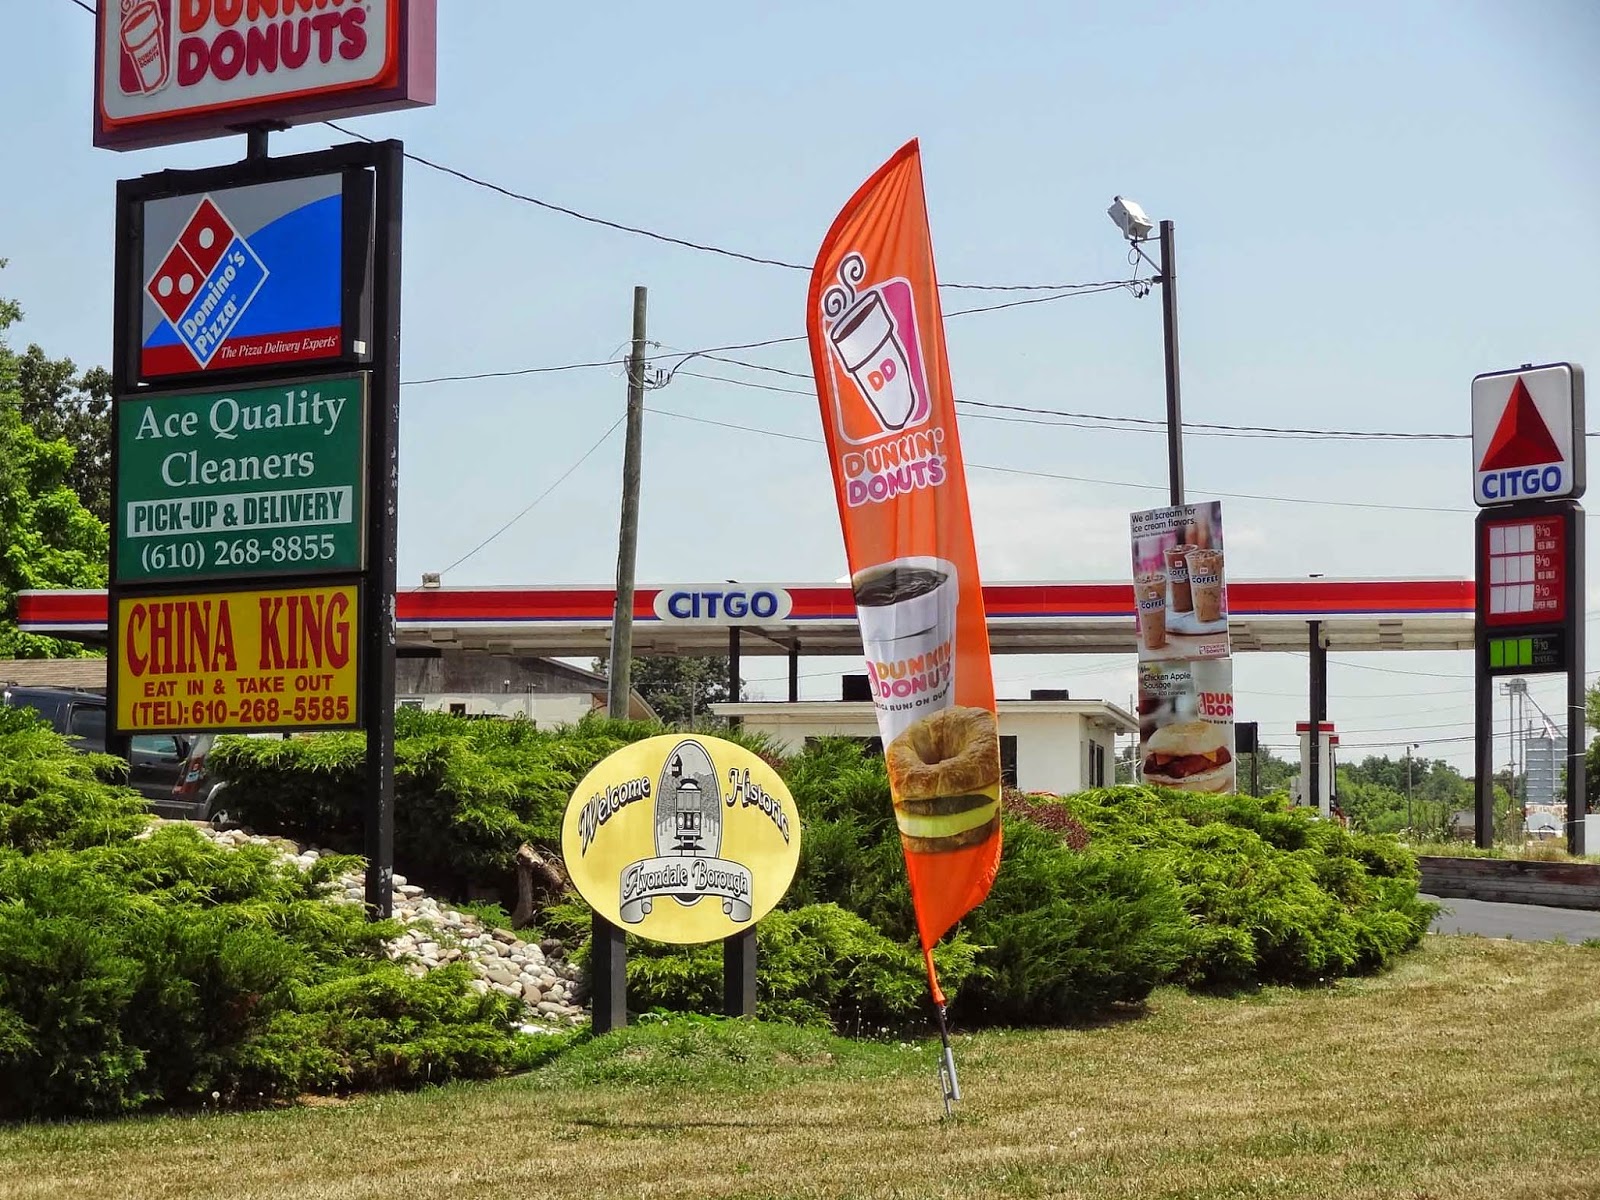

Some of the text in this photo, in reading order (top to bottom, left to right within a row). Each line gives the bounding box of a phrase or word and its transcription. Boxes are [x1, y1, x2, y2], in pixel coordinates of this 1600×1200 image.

[178, 7, 367, 86] DONUTS
[181, 251, 245, 339] Domino's
[194, 299, 238, 355] Pizza
[221, 336, 336, 359] The Pizza Delivery Experts
[867, 358, 897, 392] DD
[135, 389, 347, 440] Ace Quality
[161, 449, 315, 487] Cleaners
[844, 428, 944, 479] DUNKIN'
[848, 457, 945, 505] DONUTS
[1482, 466, 1562, 499] CITGO
[134, 491, 343, 533] PICK-UP & DELIVERY
[1131, 507, 1196, 523] We all scream for
[1132, 524, 1142, 532] ice
[1144, 521, 1166, 531] cream
[141, 533, 335, 572] (610) 268-8855
[668, 591, 778, 618] CITGO
[126, 592, 350, 677] CHINA KING
[144, 674, 334, 697] EAT IN & TAKE OUT
[1144, 672, 1191, 681] Chicken Apple
[1144, 682, 1171, 690] Sausage
[890, 703, 913, 711] RUNS
[915, 697, 930, 706] ON
[578, 768, 790, 857] Welcome Historic
[623, 860, 748, 899] Avondale Borough
